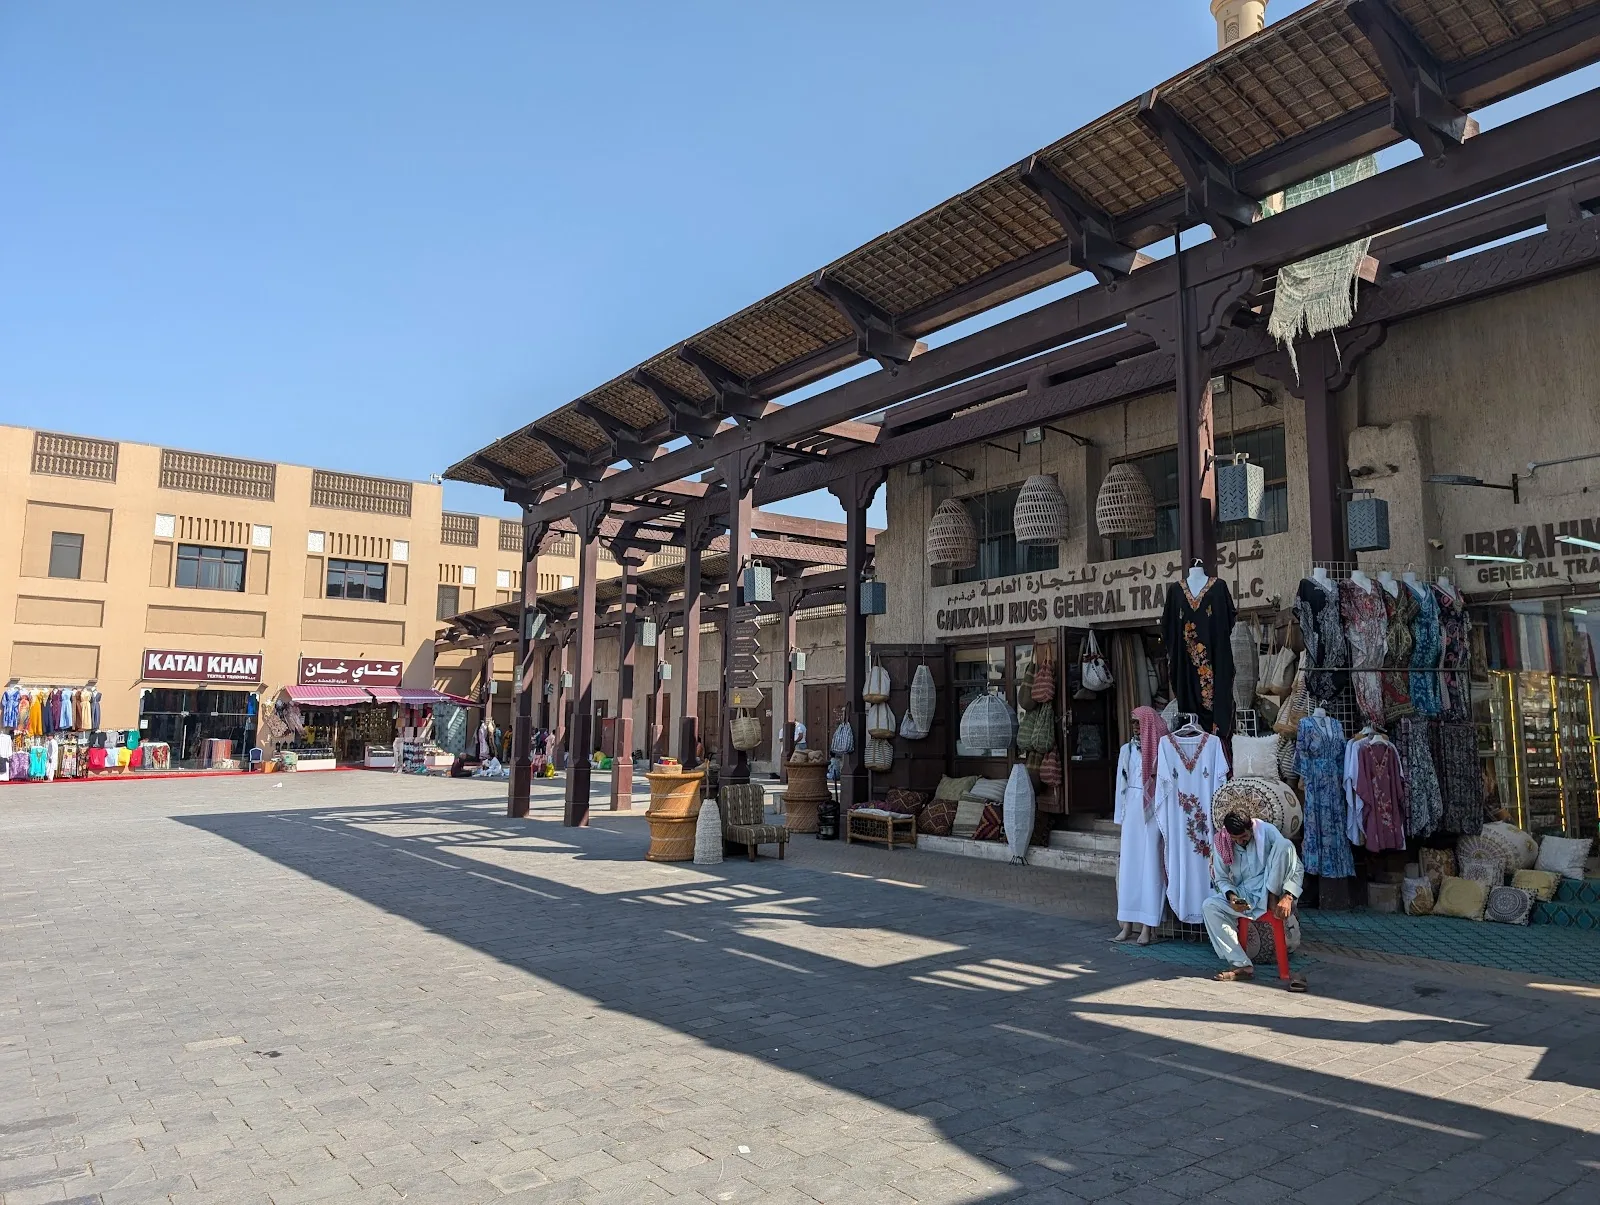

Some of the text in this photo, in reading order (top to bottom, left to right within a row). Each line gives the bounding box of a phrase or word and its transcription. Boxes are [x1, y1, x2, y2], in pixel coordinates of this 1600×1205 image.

[1478, 560, 1558, 583] GENERAL
[980, 577, 1021, 597] العامة
[936, 603, 1004, 630] CHUKPALU
[1008, 598, 1047, 623] RUGS
[1054, 590, 1126, 618] GENERAL
[148, 654, 258, 674] KATAI KHAN
[305, 662, 401, 683] كتاي خان
